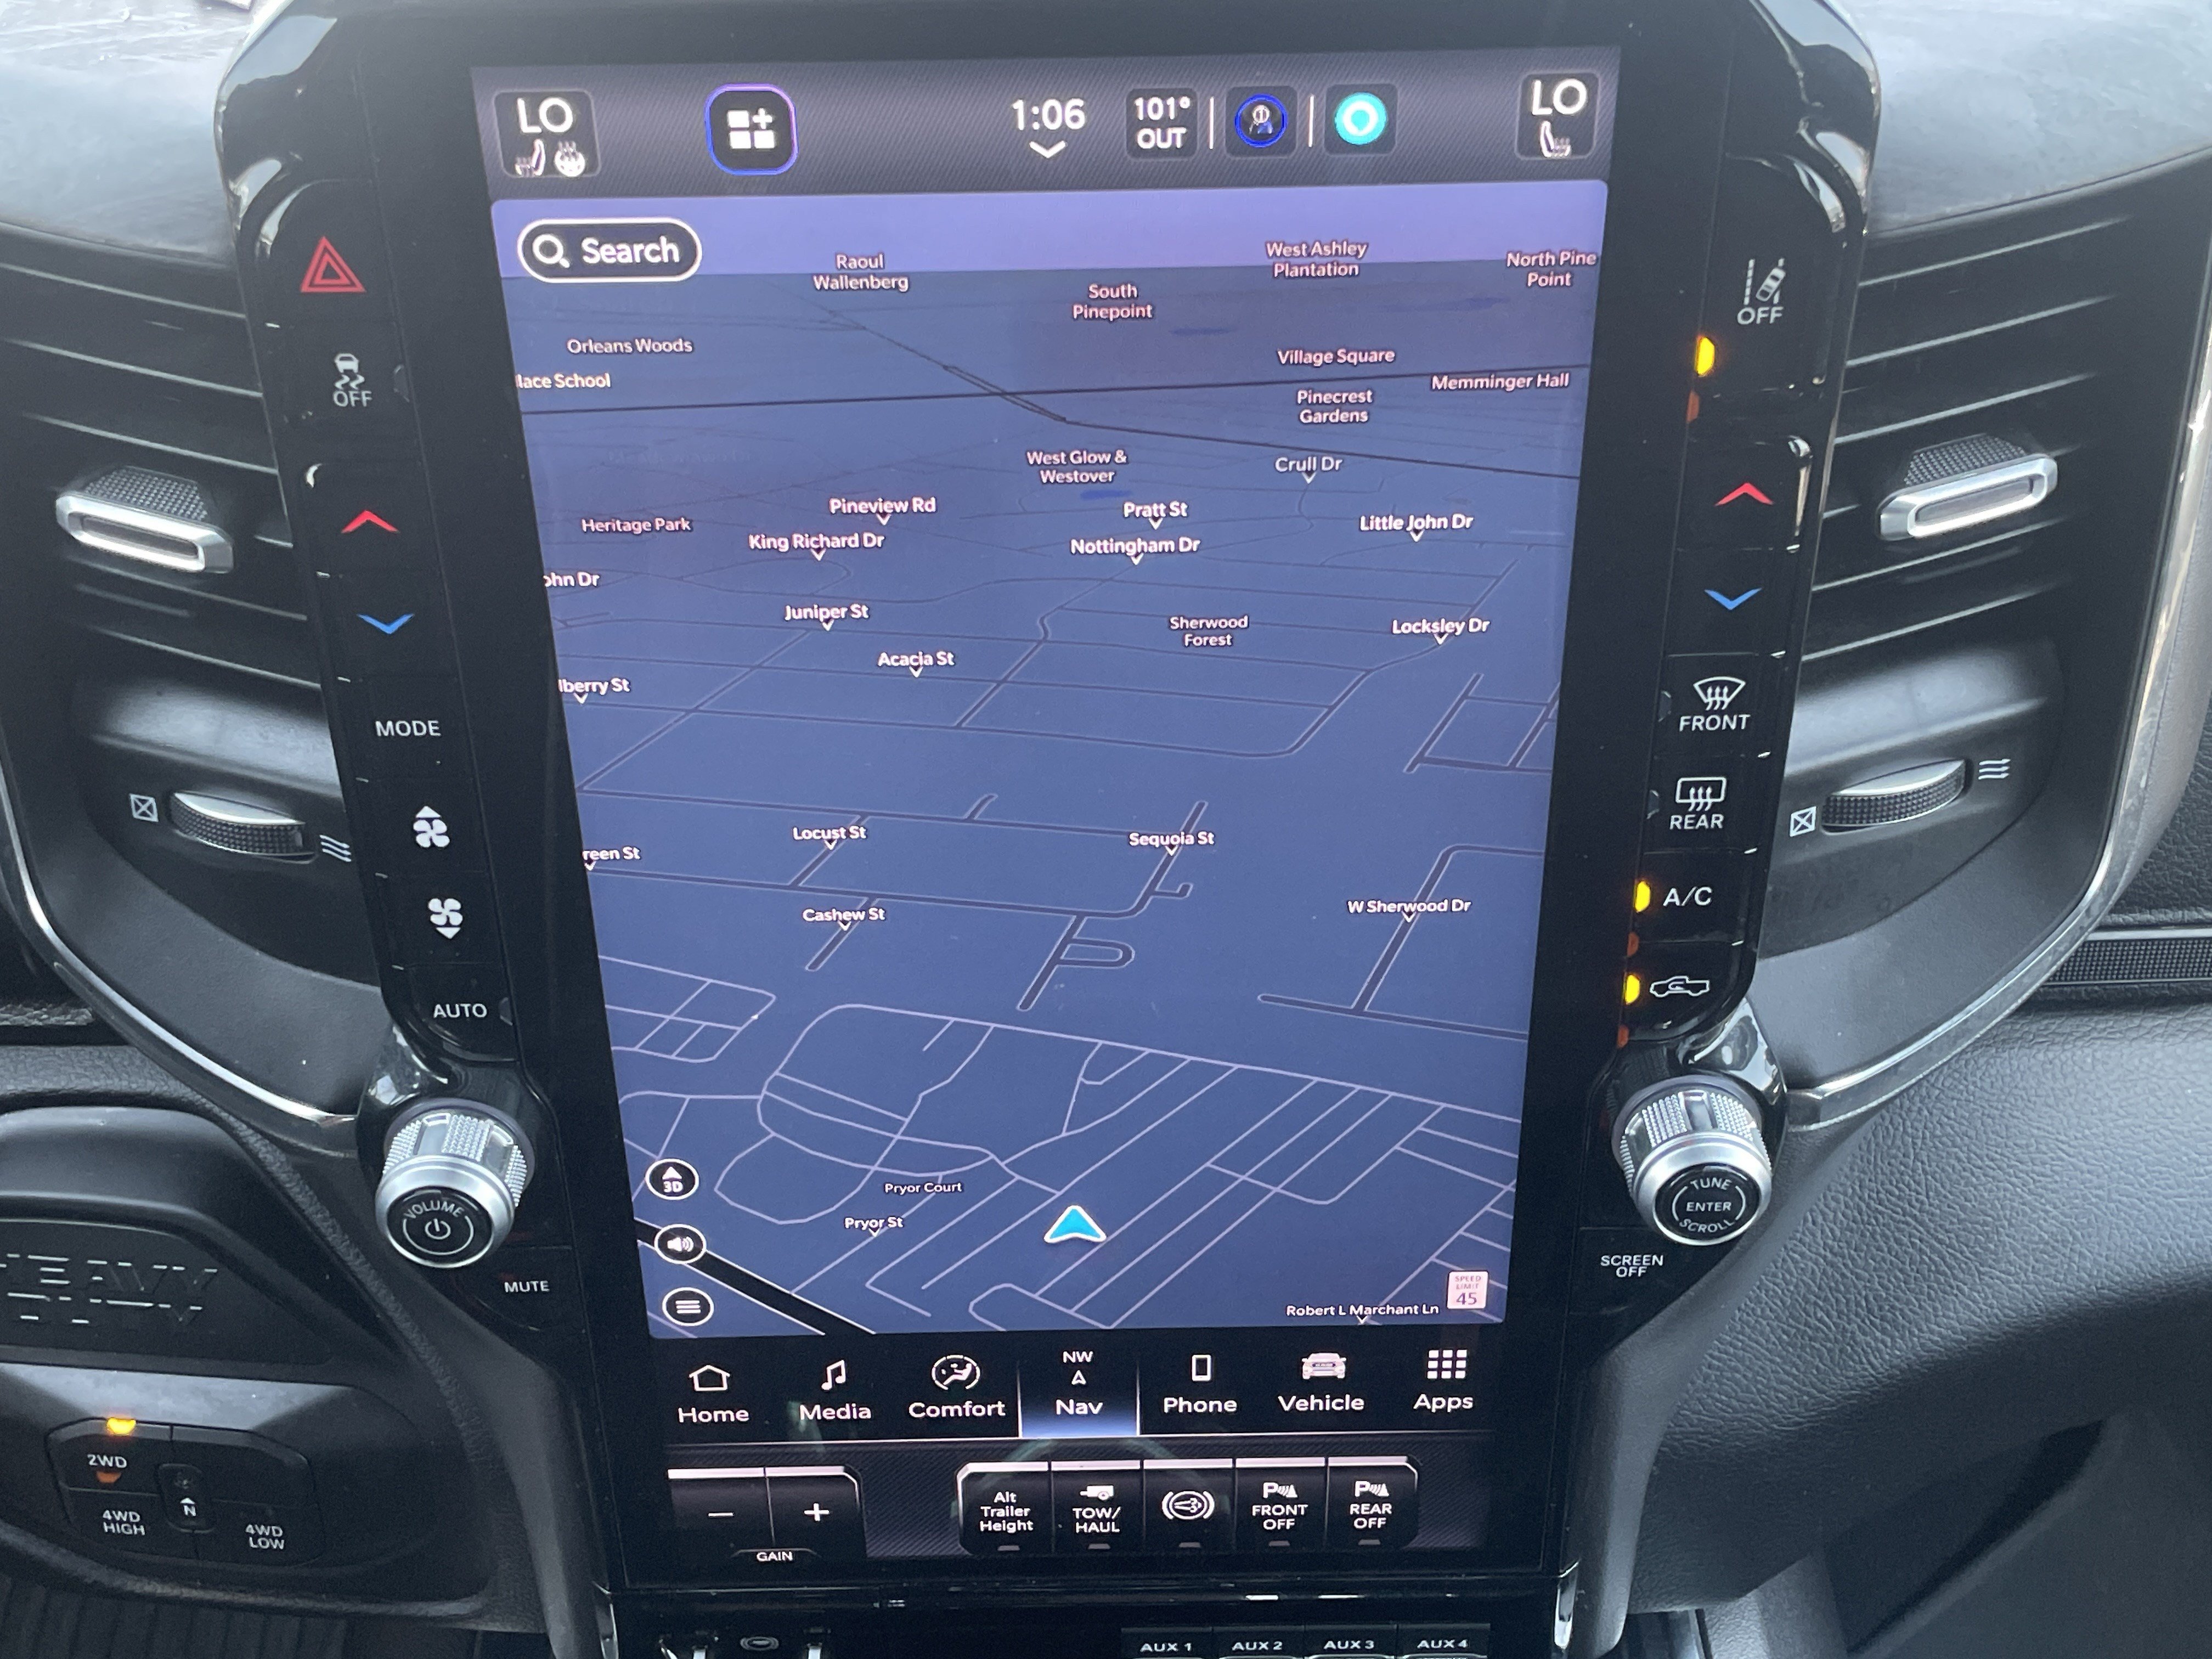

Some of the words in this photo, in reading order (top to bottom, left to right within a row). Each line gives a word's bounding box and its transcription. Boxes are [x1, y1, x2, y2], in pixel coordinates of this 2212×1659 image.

[1532, 79, 1587, 115] LO
[517, 98, 573, 133] LO
[1012, 99, 1087, 131] 1:06
[1137, 127, 1187, 149] OUT
[582, 237, 679, 264] Search
[1266, 242, 1307, 258] West
[1310, 241, 1367, 258] Ashley
[836, 253, 884, 270] Raoul
[1506, 250, 1554, 267] North
[1559, 251, 1596, 266] Pine
[1273, 262, 1359, 278] Plantation
[813, 275, 909, 294] Wallenberg
[1527, 272, 1571, 287] Point
[1088, 283, 1138, 298] South
[1073, 304, 1153, 321] Pinepoint
[1737, 306, 1784, 325] OFF
[567, 337, 633, 354] Orleans
[636, 337, 693, 354] Woods
[1278, 349, 1334, 366] Village
[1336, 348, 1395, 365] Square
[555, 373, 611, 389] School
[1432, 375, 1533, 391] Memminger
[1537, 373, 1569, 387] Hall
[334, 391, 372, 407] OFF
[1297, 390, 1373, 405] Pinecrest
[1300, 408, 1368, 424] Gardens
[1027, 451, 1066, 465] West
[1069, 450, 1111, 465] Glow
[1115, 450, 1127, 464] &
[1275, 457, 1317, 473] Crull
[1321, 457, 1343, 471] Dr
[1040, 470, 1115, 483] Westover
[830, 499, 909, 514] Pineview
[912, 497, 936, 512] Rd
[1124, 501, 1166, 518] Pratt
[1169, 500, 1188, 517] St
[582, 518, 652, 534] Heritage
[656, 517, 691, 532] Park
[1360, 515, 1403, 532] Little
[1406, 515, 1448, 530] John
[1452, 514, 1474, 529] Dr
[749, 534, 789, 551] King
[792, 533, 859, 549] Richard
[863, 533, 885, 548] Dr
[1071, 538, 1175, 556] Nottingham
[1178, 538, 1200, 553] Dr
[578, 572, 600, 588] Dr
[785, 605, 847, 622] Juniper
[850, 603, 869, 619] St
[1170, 616, 1248, 630] Sherwood
[1392, 619, 1465, 636] Locksley
[1469, 618, 1490, 634] Dr
[1184, 634, 1232, 647] Forest
[878, 651, 933, 667] Acacia
[936, 651, 955, 665] St
[612, 678, 630, 692] St
[375, 720, 441, 737] MODE
[1679, 714, 1751, 732] FRONT
[1669, 814, 1724, 830] REAR
[793, 826, 847, 840] Locust
[849, 825, 867, 839] St
[1129, 832, 1194, 848] Sequoia
[1198, 832, 1215, 845] St
[623, 845, 640, 860] St
[1663, 886, 1712, 907] A/C
[1347, 900, 1364, 914] W
[1367, 899, 1448, 914] Sherwood
[1451, 899, 1471, 912] Dr
[803, 908, 865, 922] Cashew
[869, 907, 886, 921] St
[433, 1004, 487, 1018] AUTO
[664, 1181, 683, 1193] 3D
[884, 1182, 921, 1195] Pryor
[924, 1181, 962, 1193] Court
[1690, 1178, 1733, 1190] TUNE
[403, 1200, 464, 1219] VOLUME
[1686, 1201, 1732, 1212] ENTER
[844, 1217, 883, 1231] Pryor
[887, 1216, 903, 1229] St
[1679, 1218, 1734, 1233] SCROLL
[1600, 1255, 1663, 1267] SCREEN
[1616, 1266, 1647, 1278] OFF
[504, 1280, 550, 1293] MUTE
[1456, 1292, 1478, 1306] 45
[1286, 1305, 1336, 1316] Robert
[1339, 1305, 1346, 1316] L
[1349, 1304, 1419, 1316] Marchant
[1423, 1303, 1439, 1314] Ln
[1063, 1351, 1093, 1363] NW
[909, 1401, 1005, 1418] Comfort
[1056, 1399, 1103, 1416] Nav
[1163, 1397, 1237, 1414] Phone
[1278, 1395, 1364, 1412] Vehicle
[1414, 1394, 1474, 1414] Apps
[678, 1407, 749, 1424] Home
[799, 1404, 872, 1420] Media
[87, 1454, 127, 1468] 2WD
[1263, 1483, 1279, 1498] P
[1355, 1481, 1370, 1497] P
[994, 1492, 1017, 1503] Alt
[102, 1509, 140, 1523] 4WD
[184, 1505, 196, 1517] N
[980, 1505, 1030, 1517] Trailer
[1073, 1506, 1121, 1520] TOW/
[1252, 1504, 1308, 1517] FRONT
[1350, 1503, 1392, 1515] REAR
[103, 1522, 145, 1536] HIGH
[980, 1520, 1033, 1533] Height
[1075, 1521, 1120, 1534] HAUL
[1263, 1518, 1295, 1531] OFF
[1354, 1516, 1387, 1529] OFF
[246, 1524, 283, 1538] 4WD
[249, 1537, 285, 1550] LOW
[757, 1551, 792, 1562] GAIN
[1140, 1641, 1178, 1652] AUX
[1183, 1643, 1193, 1652] 1
[1232, 1640, 1268, 1651] AUX
[1272, 1640, 1283, 1651] 2
[1324, 1639, 1361, 1650] AUX
[1363, 1639, 1374, 1649] 3
[1417, 1638, 1454, 1649] AUX
[1456, 1638, 1468, 1649] 4
